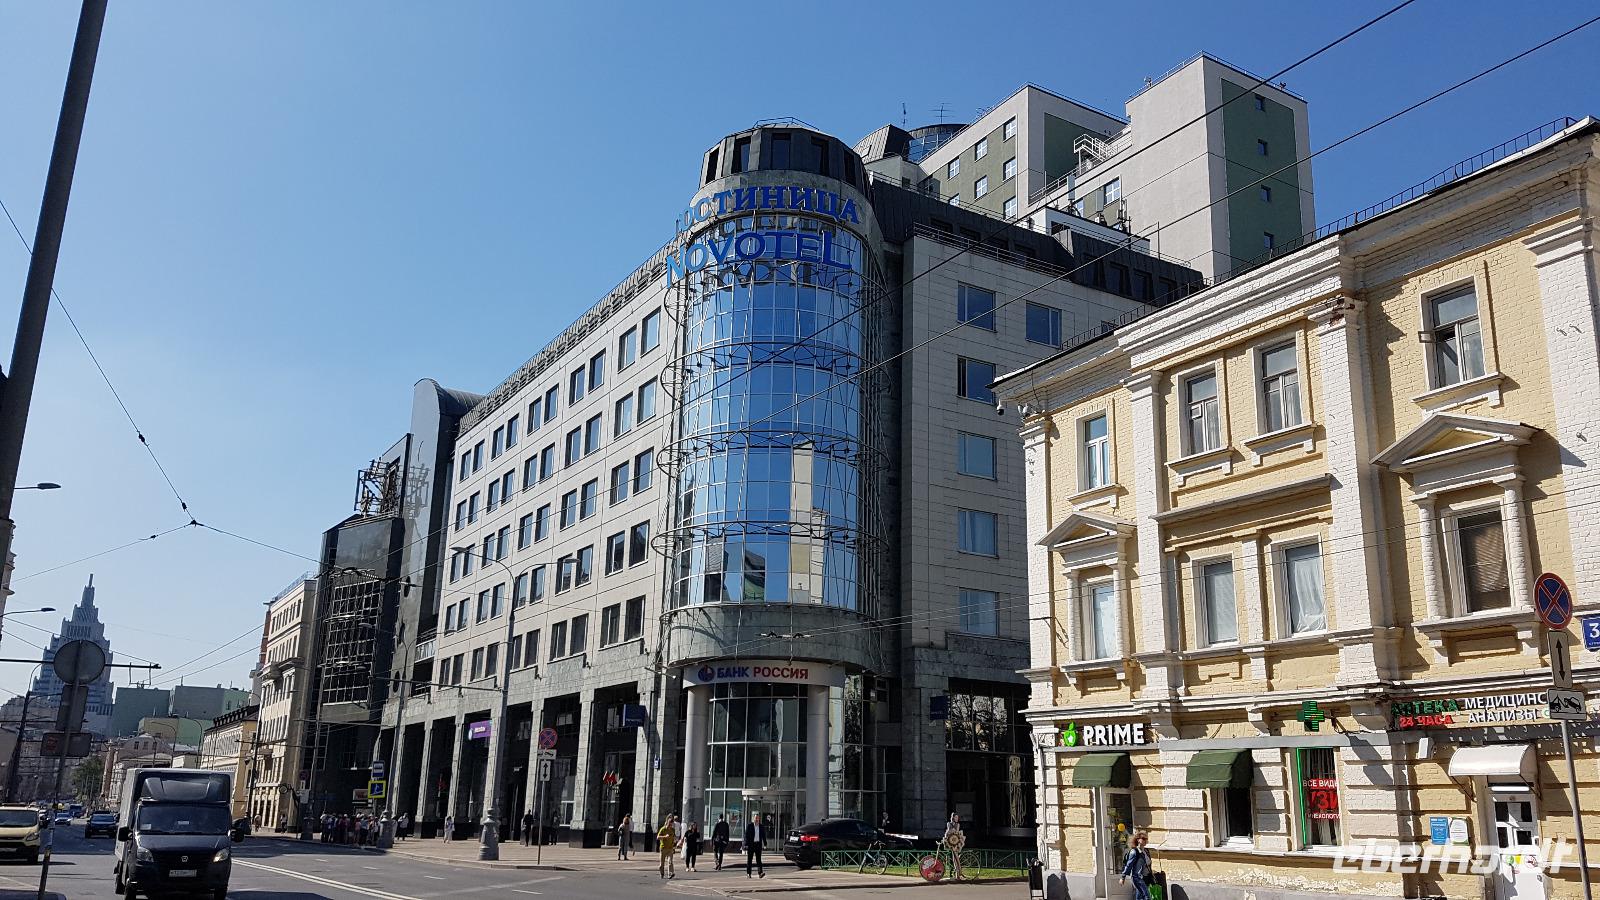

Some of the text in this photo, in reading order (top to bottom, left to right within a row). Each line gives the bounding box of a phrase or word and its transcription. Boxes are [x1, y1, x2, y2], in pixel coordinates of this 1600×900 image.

[666, 231, 852, 289] NOVOTEL
[716, 666, 809, 680] БАНК РОССИЯ
[1399, 714, 1454, 728] 24 ЧАСА
[1468, 708, 1538, 724] АНАЛИЗЫ
[1083, 723, 1145, 747] PRIME
[1303, 779, 1318, 787] ВСЕ
